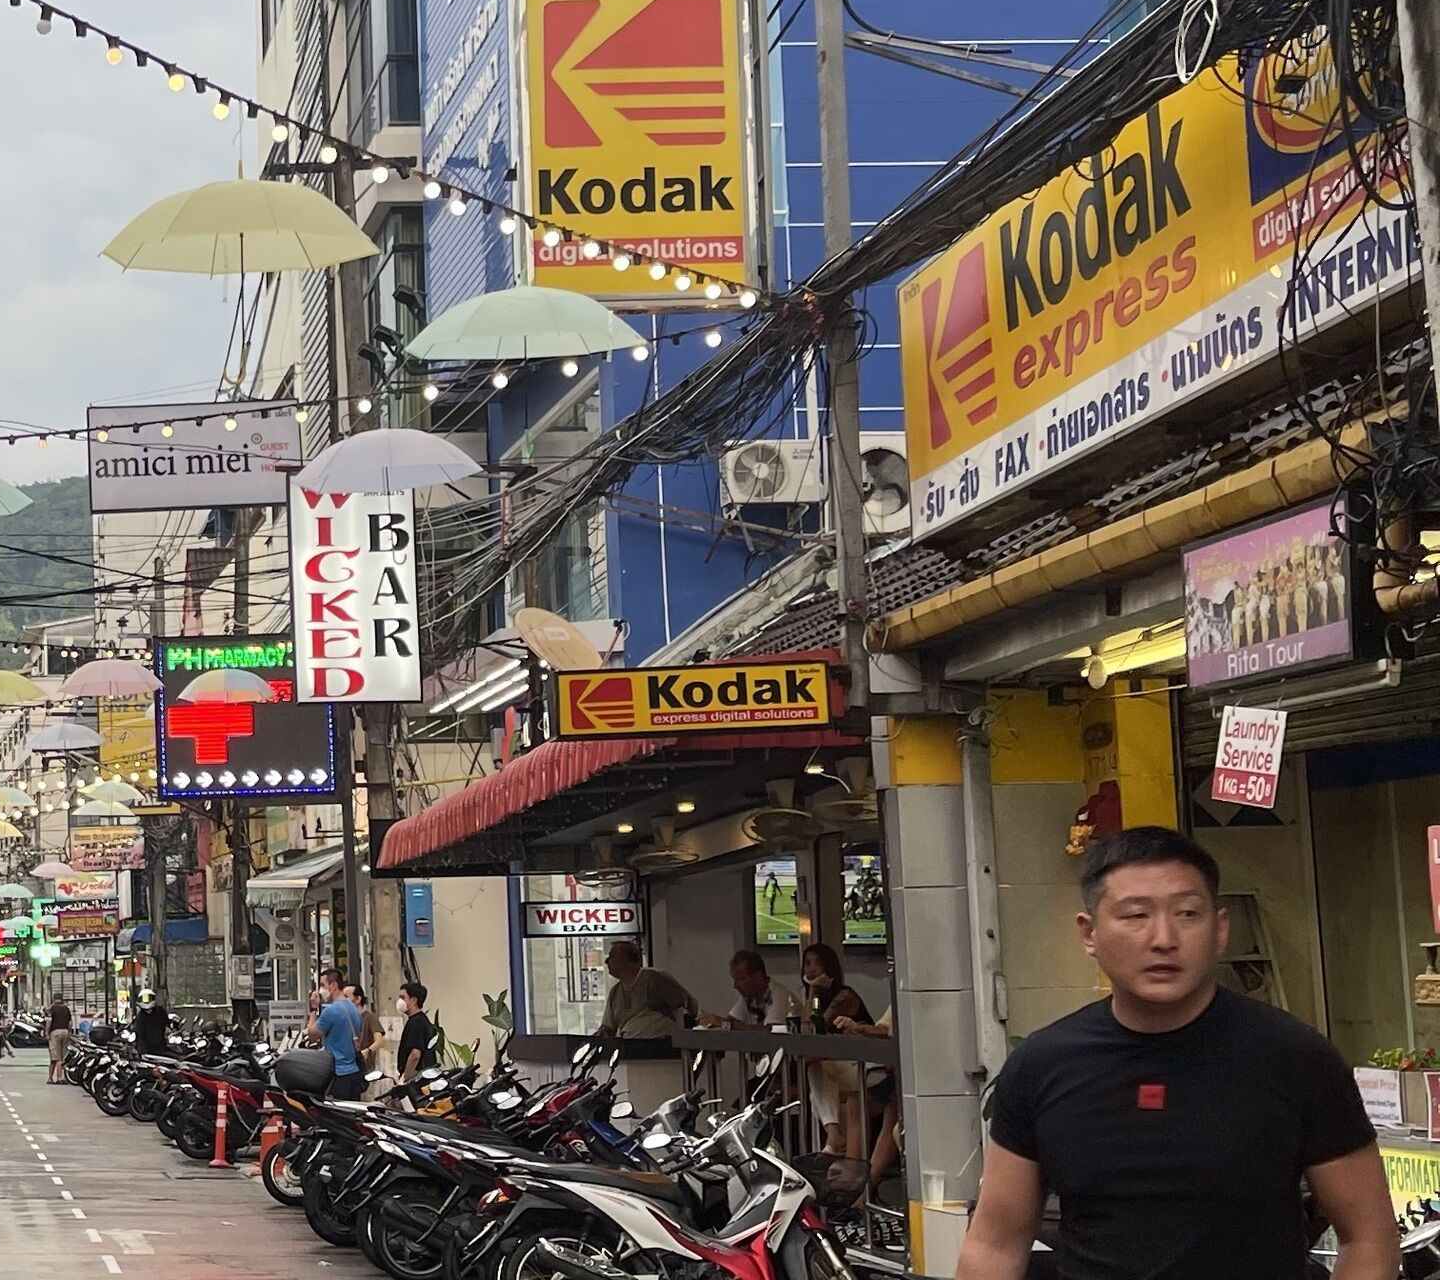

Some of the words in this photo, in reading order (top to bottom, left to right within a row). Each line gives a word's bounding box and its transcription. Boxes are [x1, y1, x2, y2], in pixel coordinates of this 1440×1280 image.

[537, 165, 735, 216] Kodak
[999, 101, 1193, 333] Kodak
[1012, 235, 1197, 390] express
[94, 446, 178, 479] amici
[185, 443, 253, 476] miei
[994, 432, 1032, 488] FAX
[366, 513, 414, 658] BAR
[1226, 652, 1260, 678] Rita
[1266, 641, 1305, 665] Tour
[647, 670, 817, 709] Kodak
[652, 713, 707, 726] express
[710, 710, 751, 724] digital
[753, 708, 815, 720] solutions
[1224, 715, 1280, 749] Laundry
[1221, 741, 1274, 772] Service
[535, 908, 635, 925] WICKED
[562, 924, 608, 932] BAR
[71, 958, 91, 966] ATM
